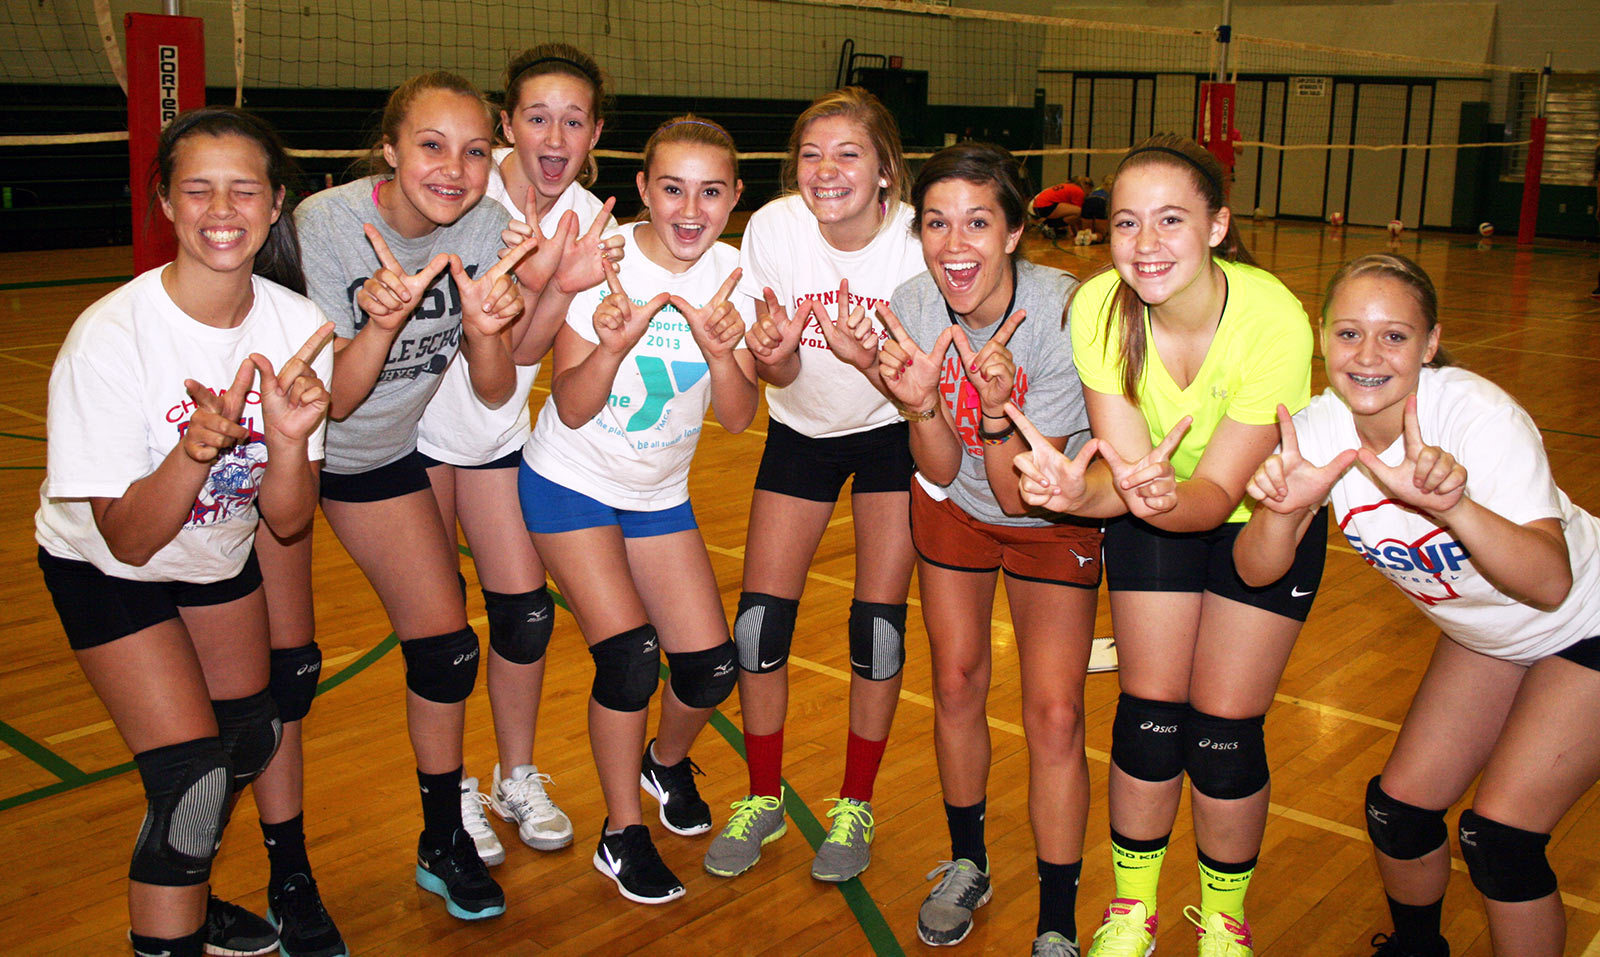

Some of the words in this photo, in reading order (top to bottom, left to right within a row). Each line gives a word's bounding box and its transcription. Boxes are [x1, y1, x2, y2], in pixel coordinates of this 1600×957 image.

[160, 47, 176, 122] PORTER
[646, 335, 681, 350] 2013
[655, 409, 671, 431] YMCA
[637, 440, 649, 450] be
[650, 440, 660, 449] all
[1152, 725, 1179, 733] asics
[1211, 742, 1239, 750] asics
